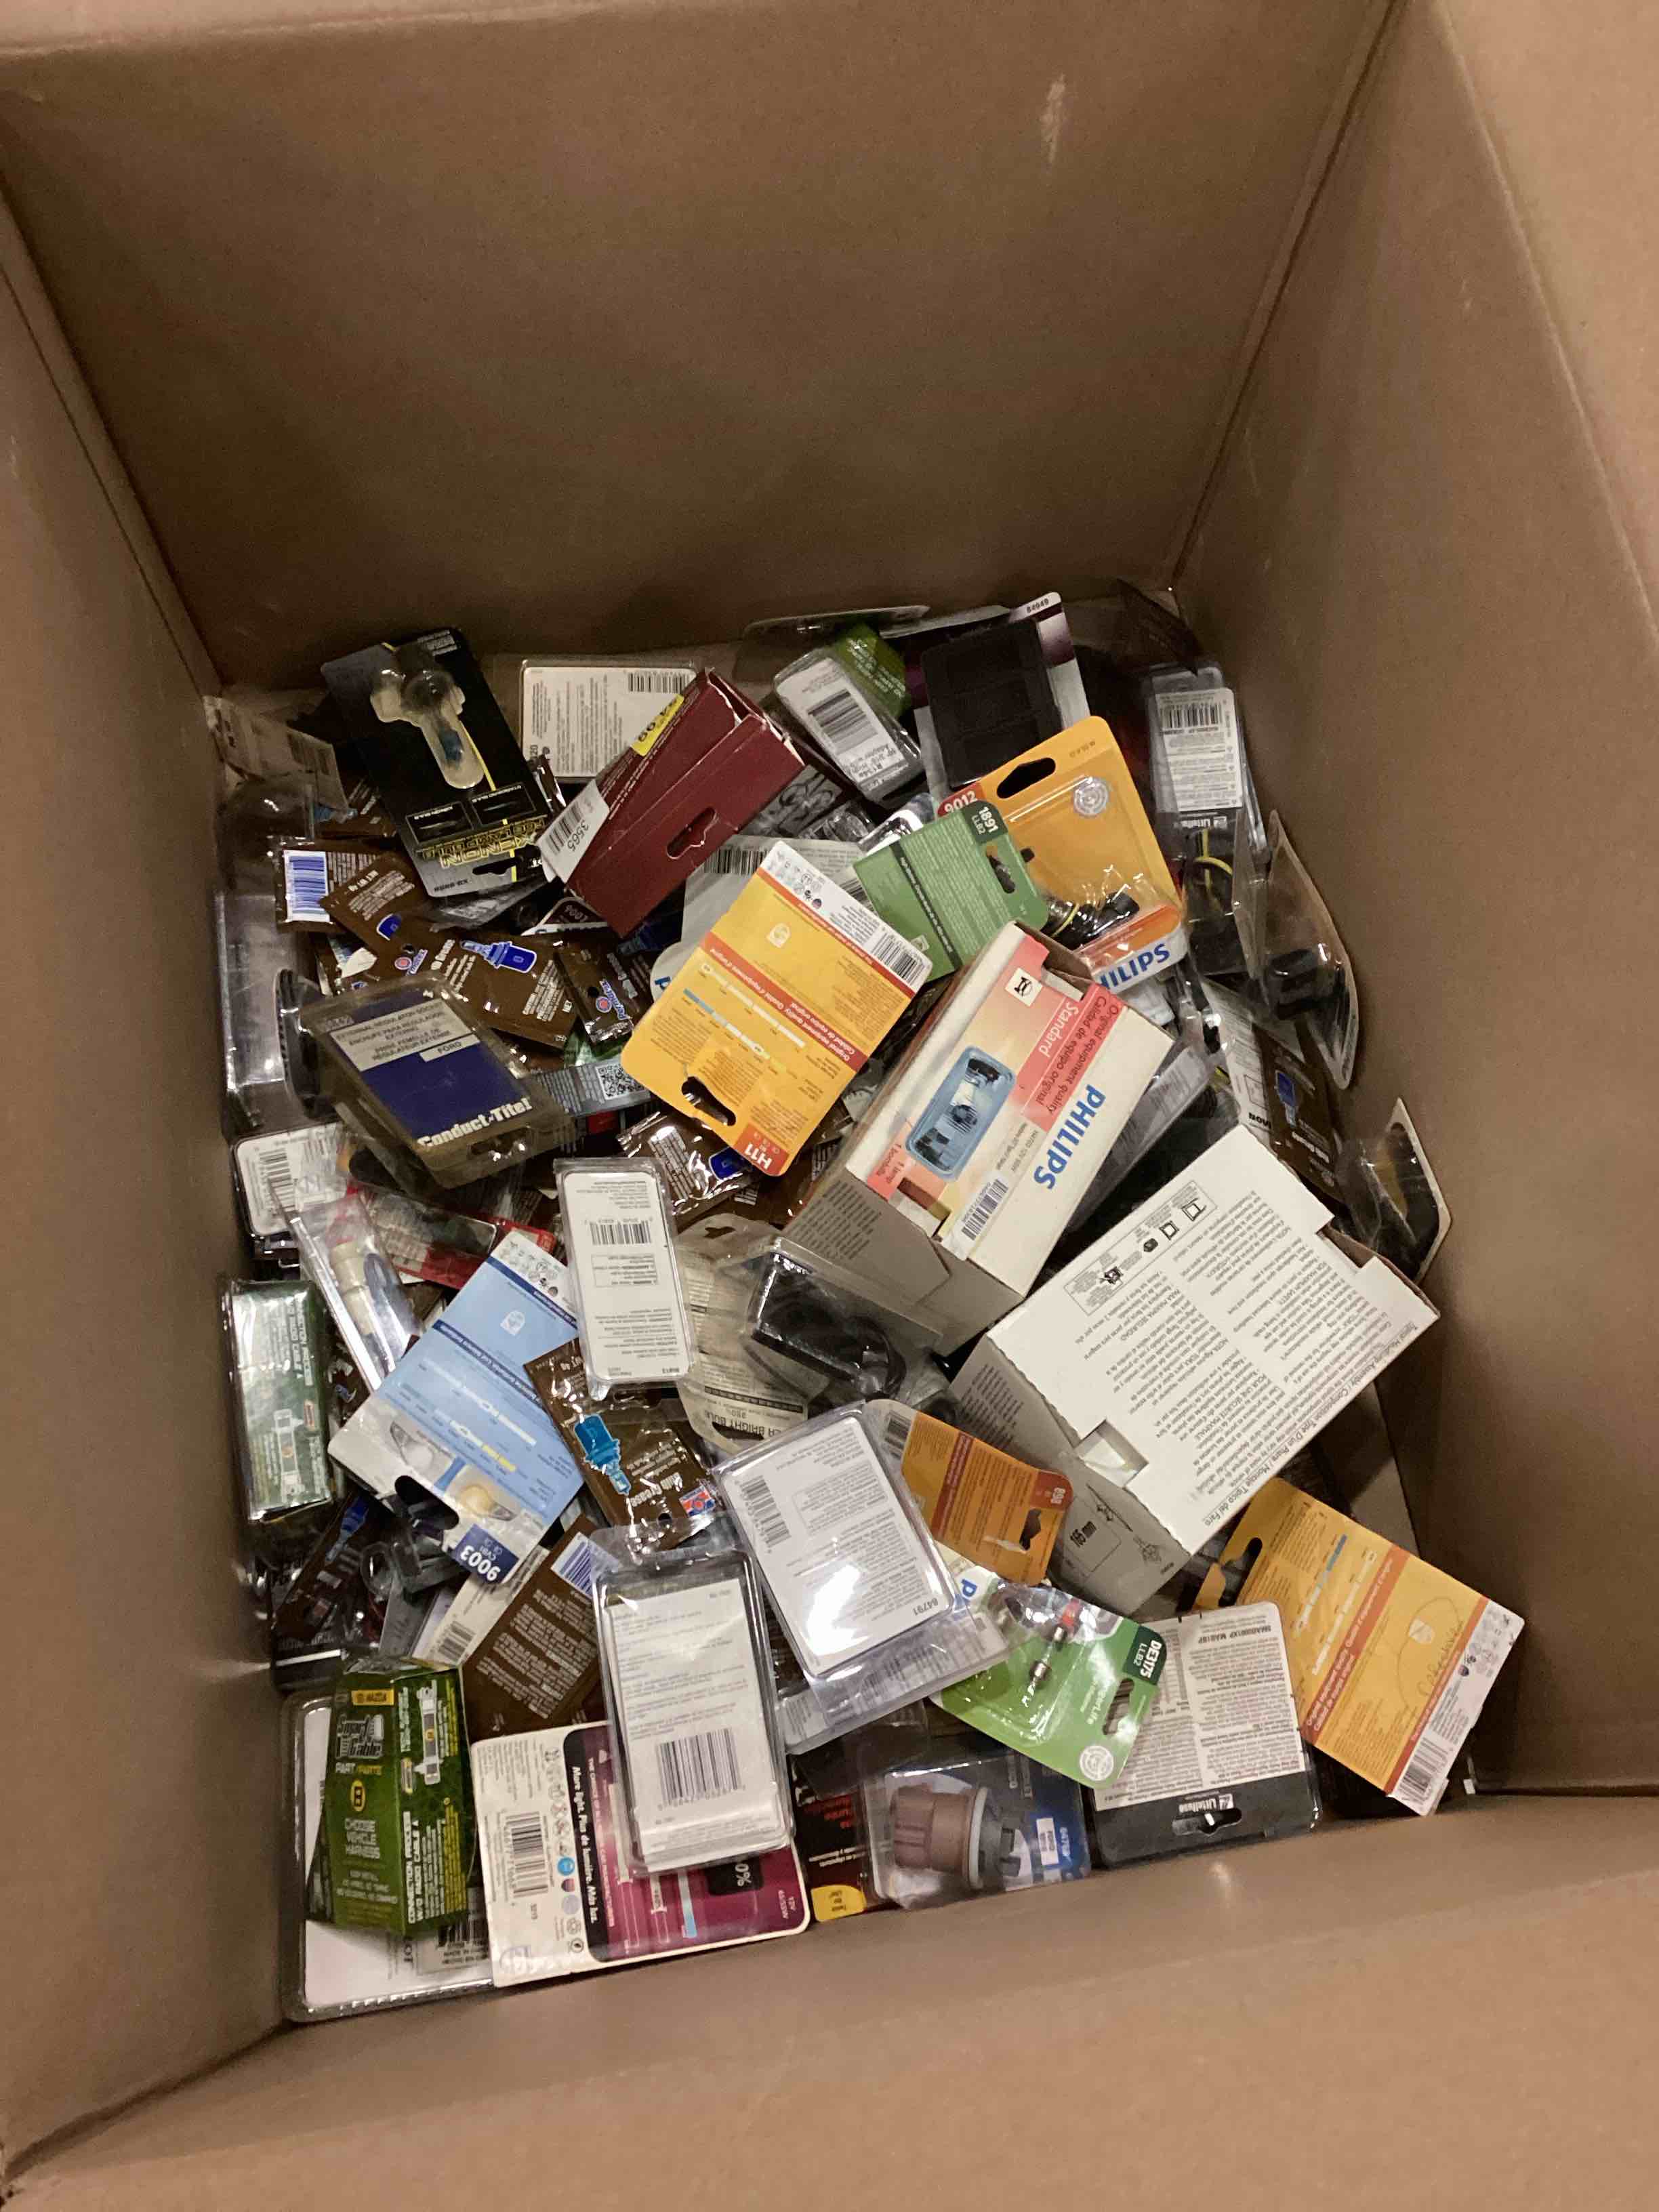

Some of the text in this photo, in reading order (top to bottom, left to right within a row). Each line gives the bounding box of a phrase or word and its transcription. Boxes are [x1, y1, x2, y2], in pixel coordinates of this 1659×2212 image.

[943, 790, 977, 814] 9012
[979, 806, 998, 832] 1891
[563, 819, 593, 852] 3565
[1098, 943, 1172, 990] HILIPS
[1036, 1000, 1080, 1058] Standard
[436, 1040, 463, 1055] FORD
[1033, 994, 1108, 1106] Calidad de equipo original
[1044, 1002, 1121, 1115] Original equipment quality
[1029, 1084, 1109, 1191] PHILIPS
[742, 1142, 774, 1170] H11
[1203, 1510, 1220, 1528] Faro
[457, 1543, 502, 1582] 9003
[1140, 1639, 1160, 1678] DE3175
[1305, 1700, 1322, 1727] Original
[571, 1765, 582, 1790] More
[573, 1791, 585, 1814] light.
[577, 1814, 588, 1832] Plus
[580, 1834, 590, 1845] de
[589, 1907, 599, 1923] luz.
